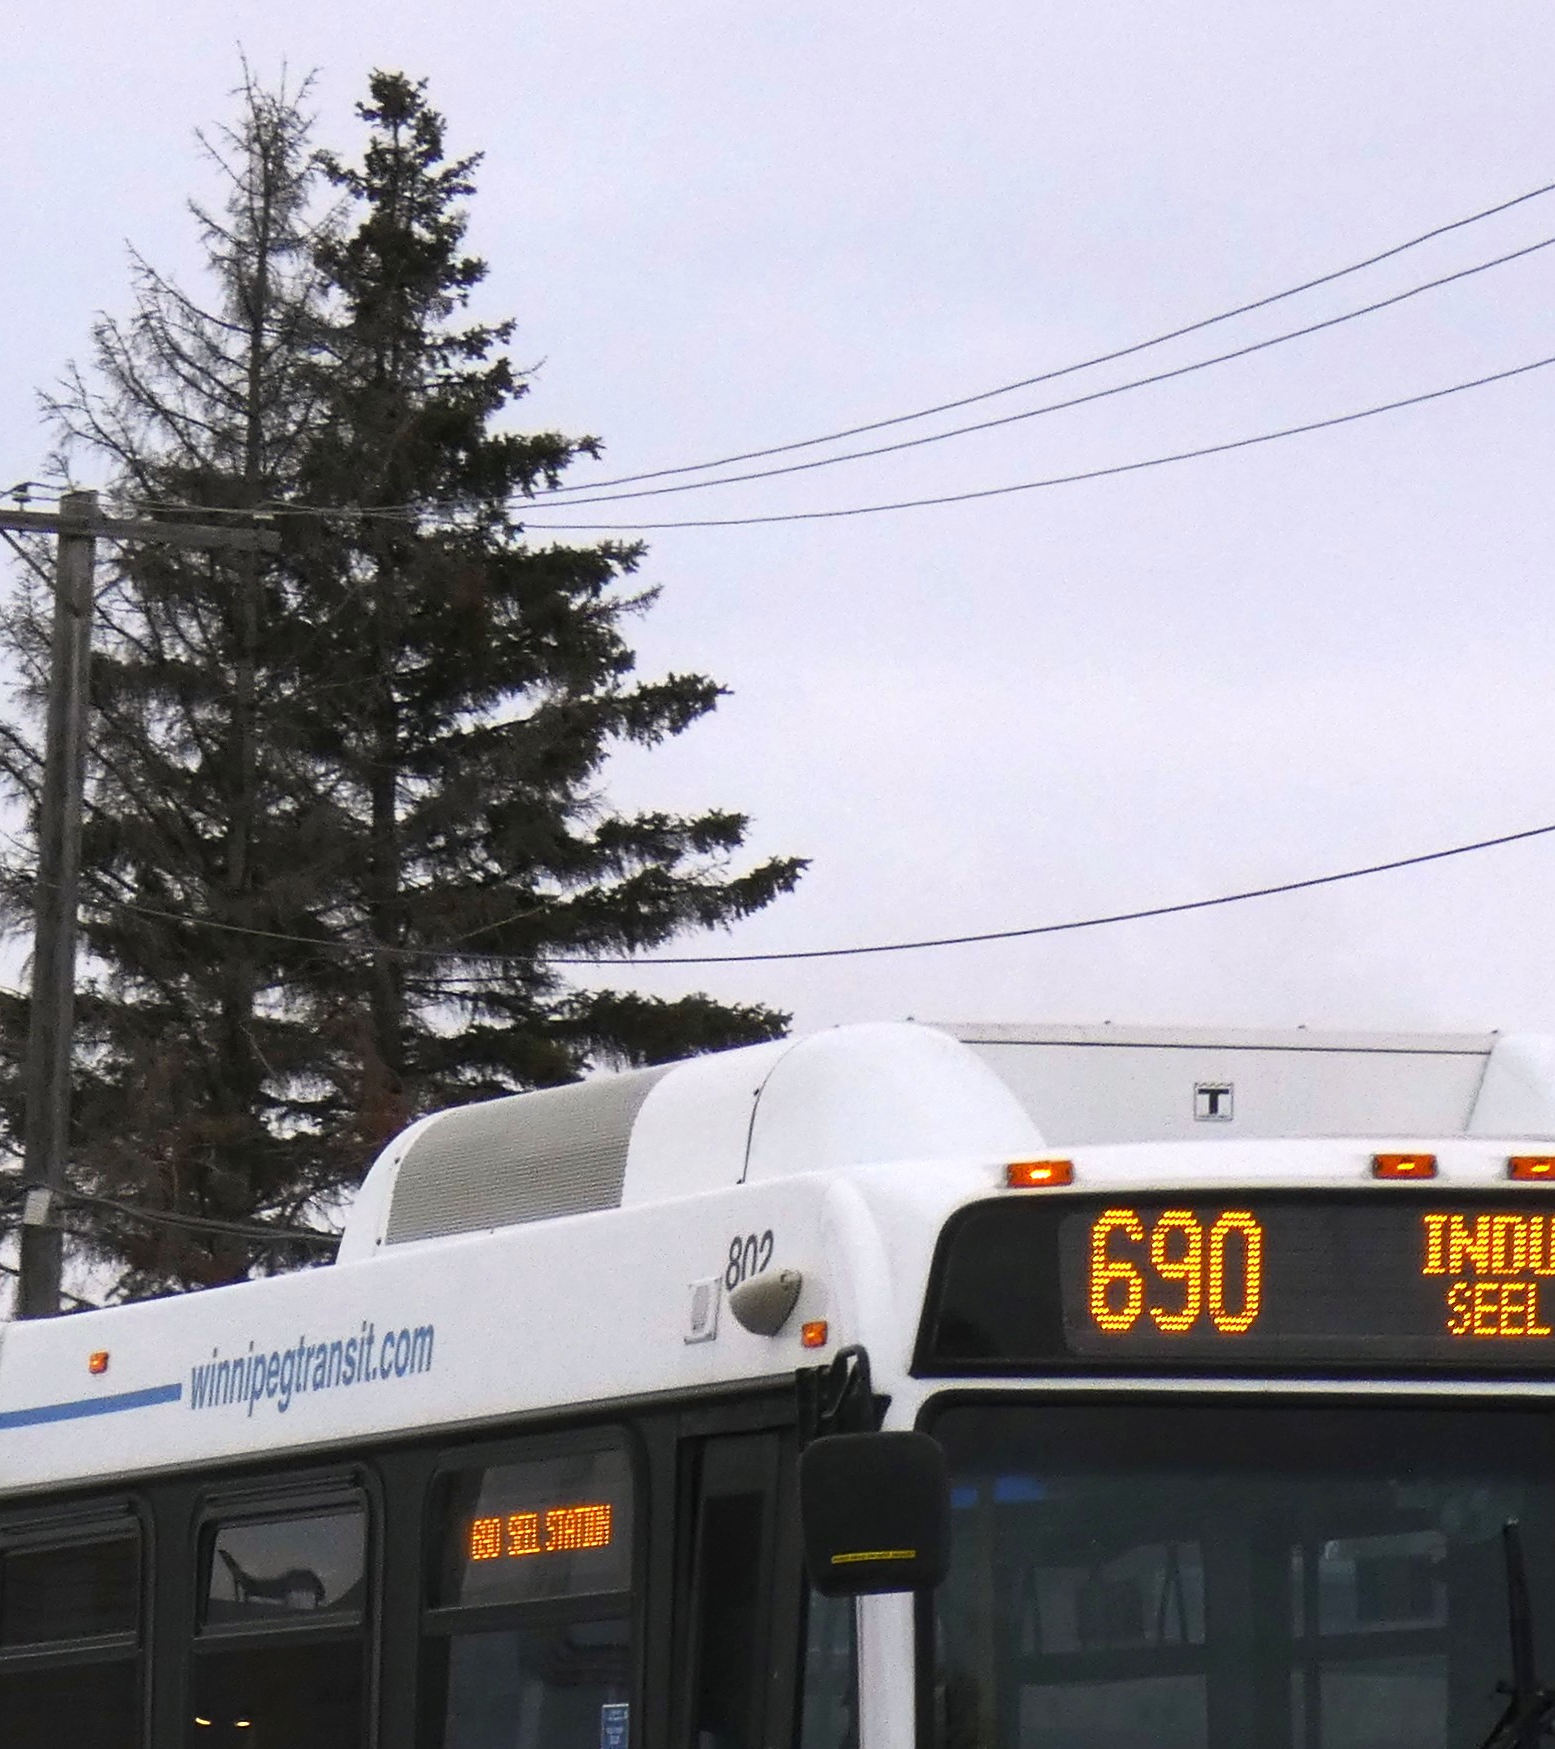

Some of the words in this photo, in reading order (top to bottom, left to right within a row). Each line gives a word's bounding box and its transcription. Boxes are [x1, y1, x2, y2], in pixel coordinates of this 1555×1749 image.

[1197, 1087, 1230, 1115] T
[725, 1229, 774, 1292] 802
[1089, 1209, 1263, 1332] 690
[1446, 1281, 1551, 1336] SEEL
[191, 1320, 435, 1418] winnipegtransit.com
